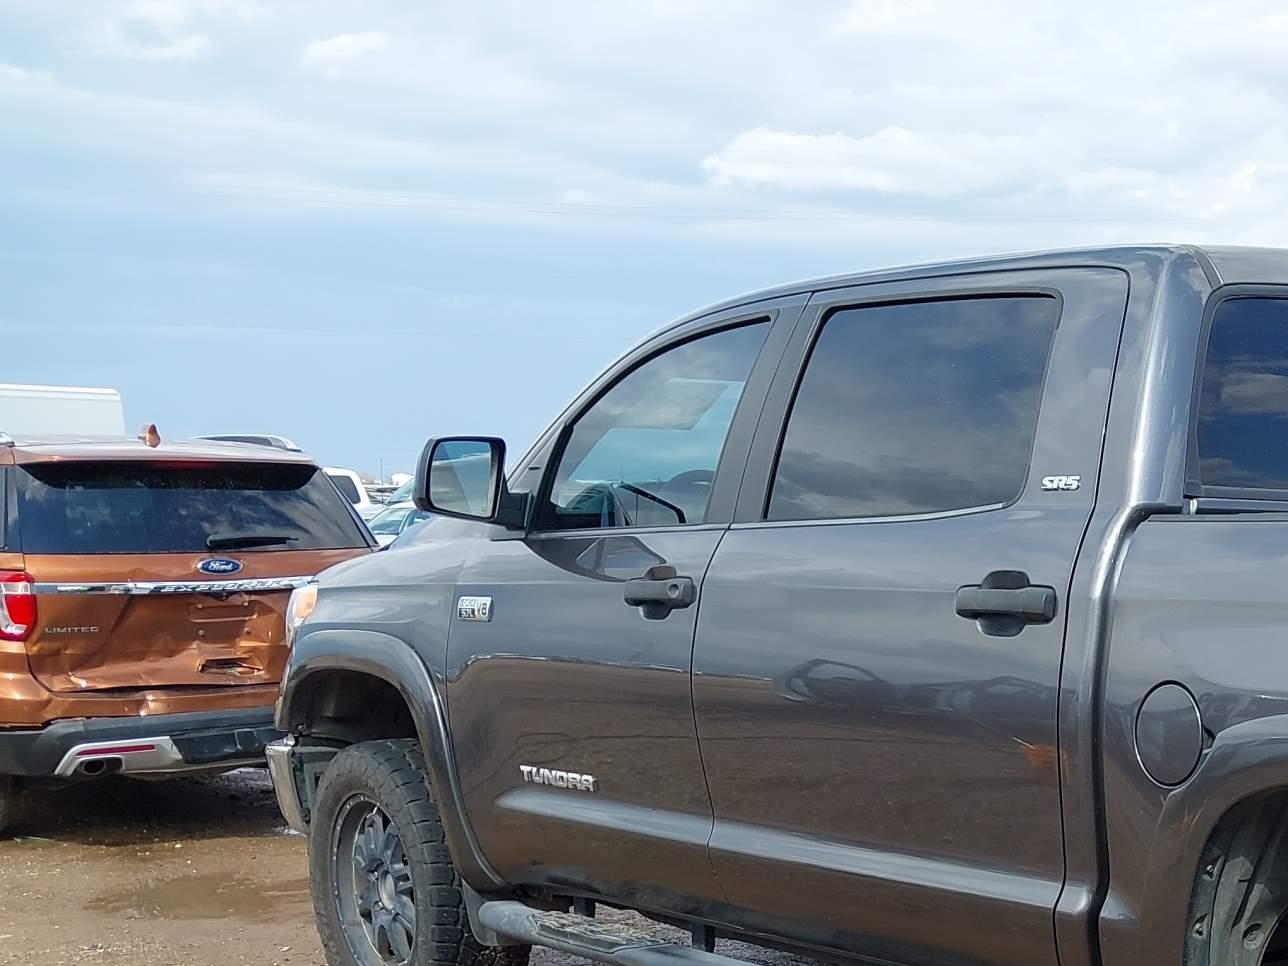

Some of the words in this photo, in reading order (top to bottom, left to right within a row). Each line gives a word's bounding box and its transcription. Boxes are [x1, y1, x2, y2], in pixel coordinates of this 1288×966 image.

[1041, 475, 1081, 490] SR5
[44, 626, 100, 634] LIMITED
[519, 765, 598, 792] TUNDRA
